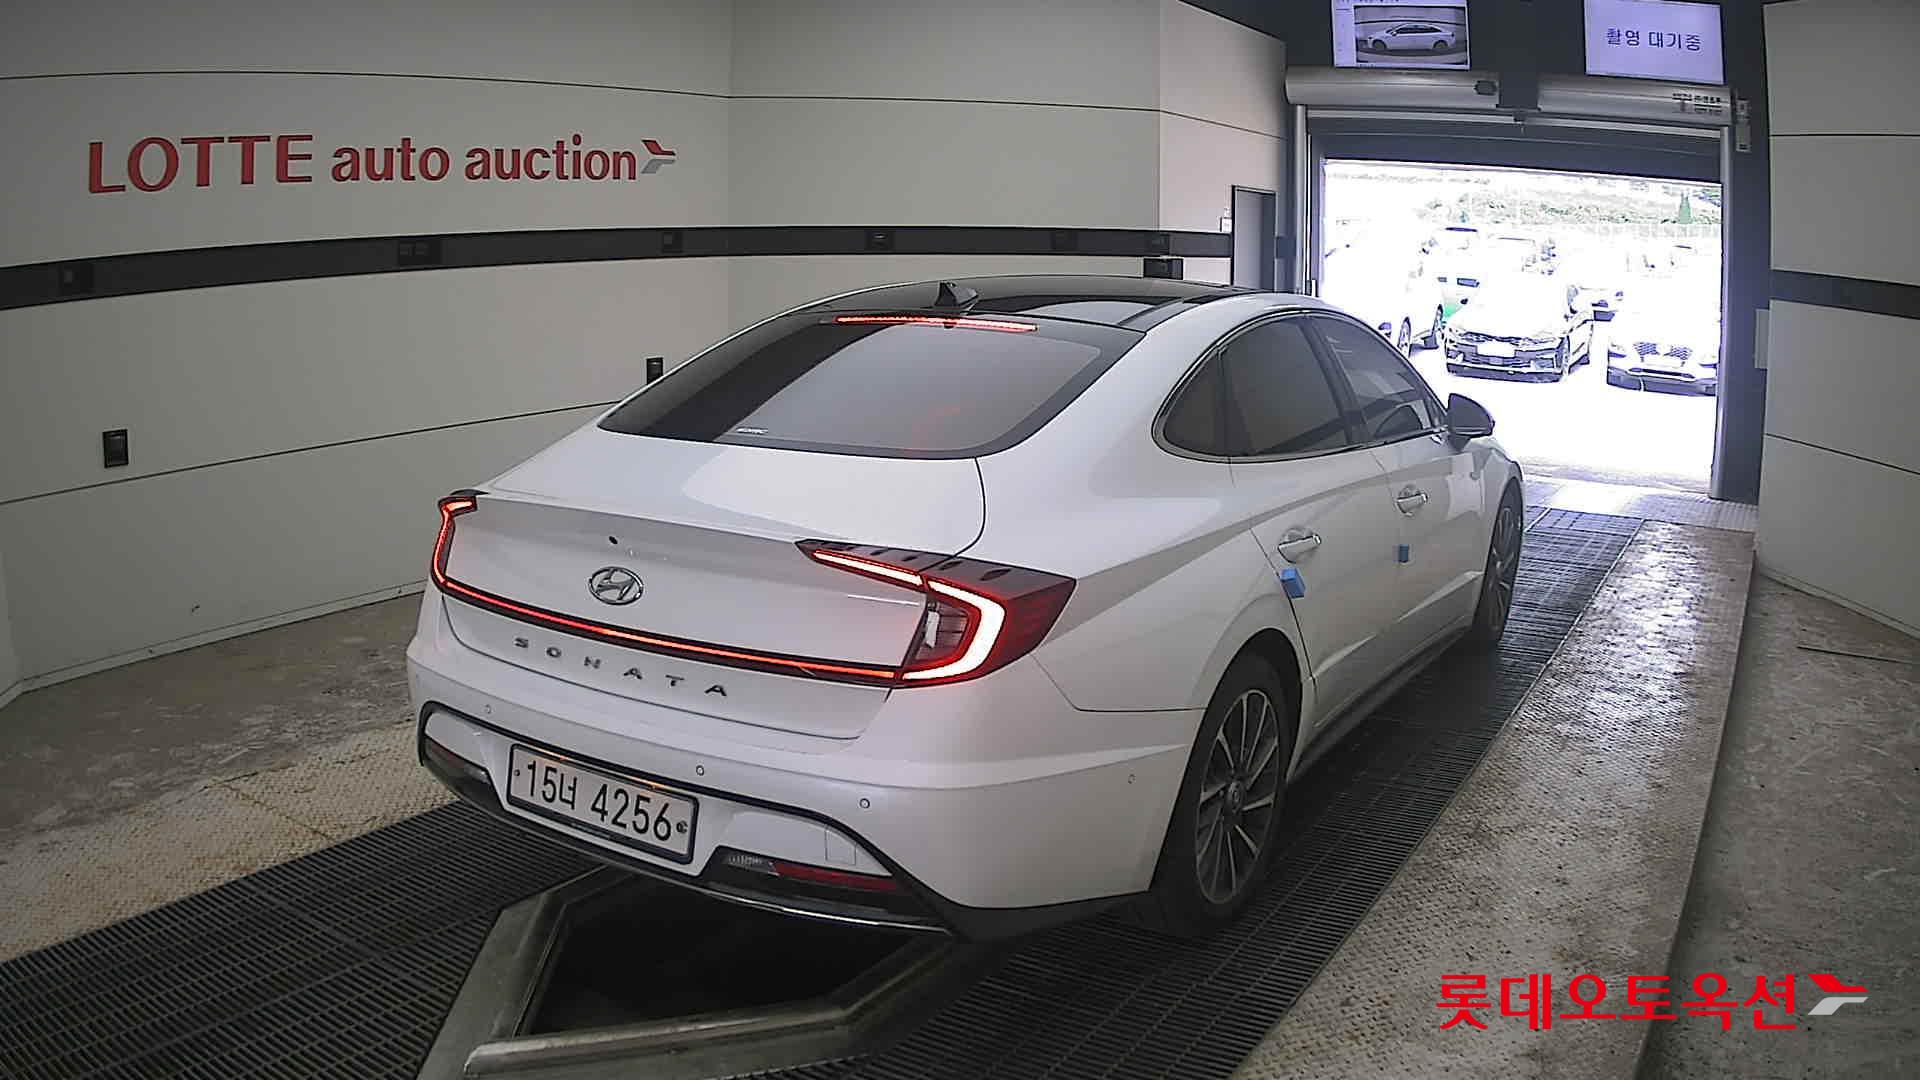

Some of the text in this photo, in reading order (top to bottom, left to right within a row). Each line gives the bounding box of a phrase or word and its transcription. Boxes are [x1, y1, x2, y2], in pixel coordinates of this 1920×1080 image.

[1607, 27, 1701, 52] 촬영 대기중
[89, 133, 638, 194] LOTTE auto auction
[513, 636, 728, 697] SONATA
[527, 760, 672, 841] 15너 4256
